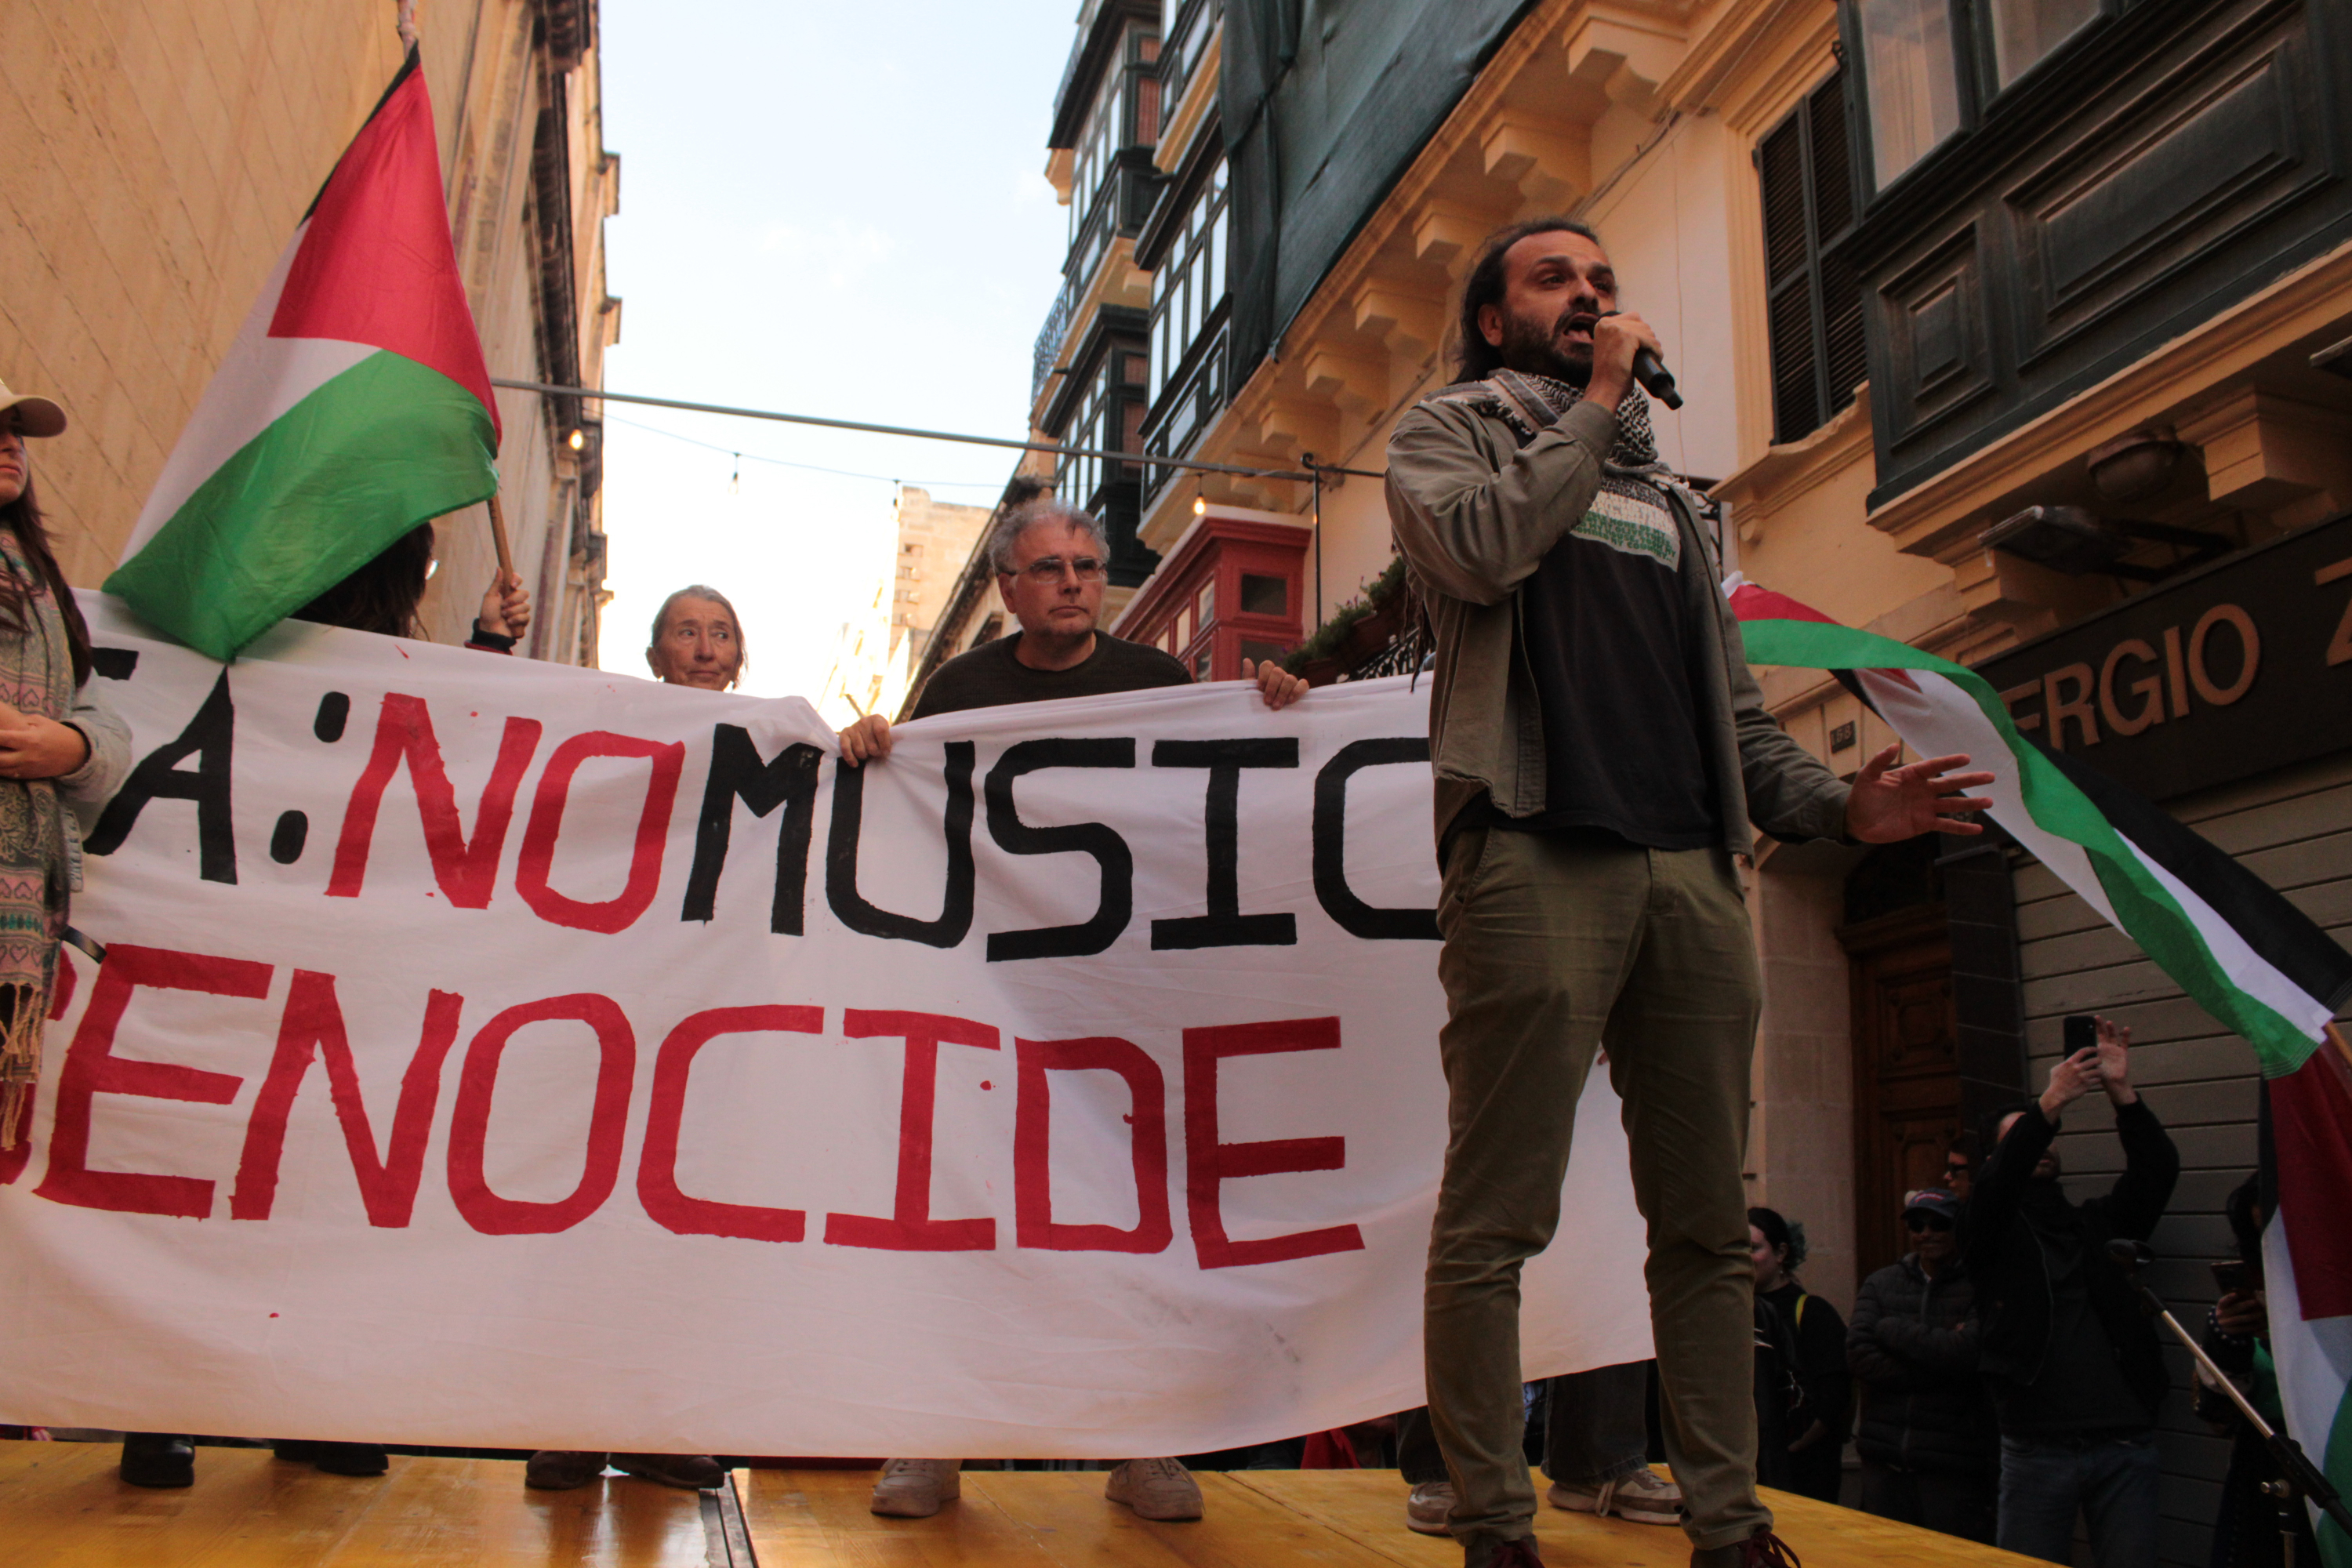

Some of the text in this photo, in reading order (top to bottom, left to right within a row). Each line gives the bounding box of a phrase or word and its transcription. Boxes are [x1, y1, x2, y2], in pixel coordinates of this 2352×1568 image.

[82, 647, 1446, 963] A: NO MUSIC
[0, 943, 1366, 1270] ENOCIDE
